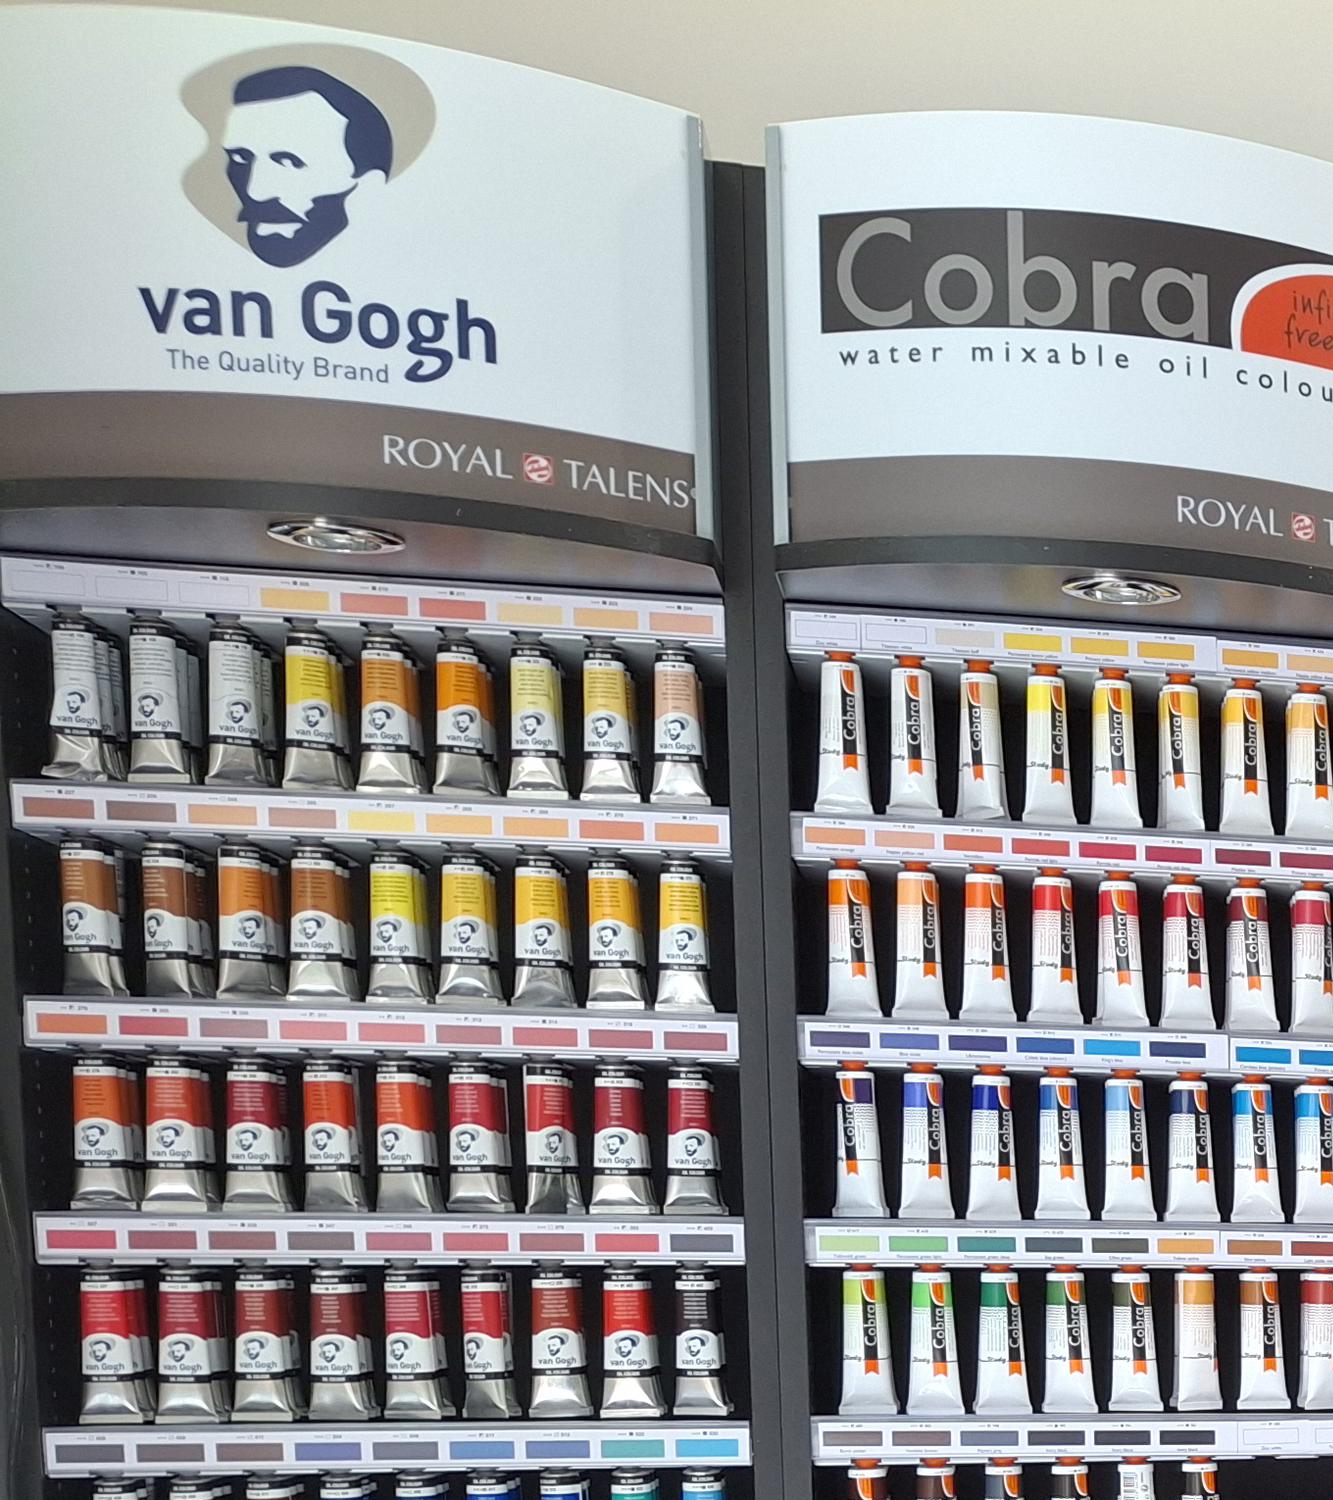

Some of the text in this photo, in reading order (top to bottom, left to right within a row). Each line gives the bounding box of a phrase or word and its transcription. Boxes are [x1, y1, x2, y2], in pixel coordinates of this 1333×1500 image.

[835, 212, 1210, 342] Cobra
[138, 280, 499, 382] van Gogh
[166, 349, 390, 383] The Quality Brand
[838, 343, 943, 368] water
[970, 339, 1131, 371] mixable
[1159, 351, 1210, 379] oil
[383, 434, 690, 506] ROYAL TALENS
[1177, 493, 1284, 536] ROYAL
[134, 718, 173, 731] van Gogh
[842, 693, 856, 740] Cobra
[1052, 710, 1065, 755] Cobra
[849, 903, 864, 949] Cobra
[1059, 1106, 1073, 1152] Cobra
[78, 1147, 118, 1160] van Gogh
